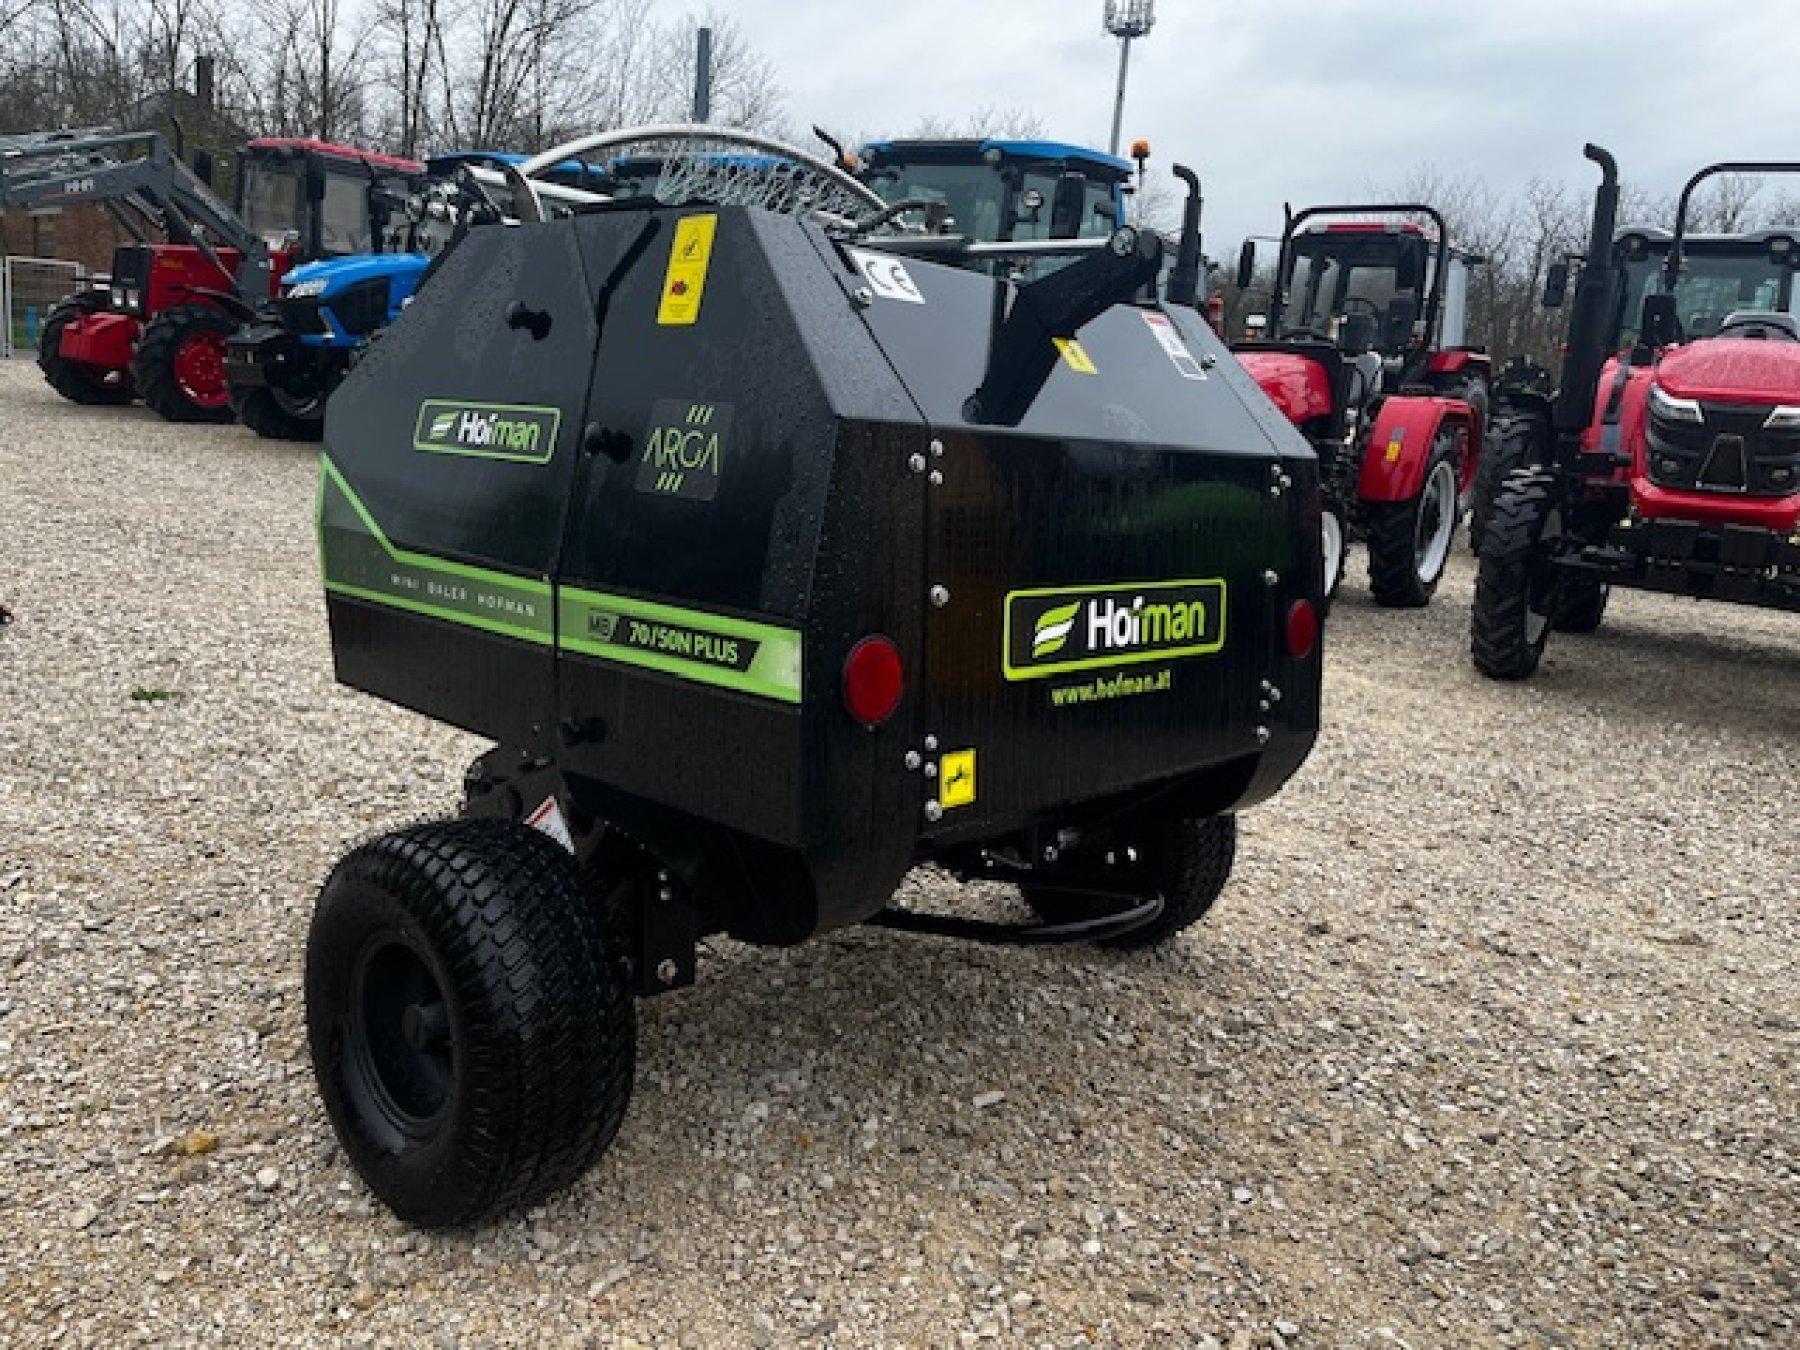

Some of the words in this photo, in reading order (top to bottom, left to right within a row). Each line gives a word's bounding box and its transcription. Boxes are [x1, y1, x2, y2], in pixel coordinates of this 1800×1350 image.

[640, 426, 718, 476] ARGA
[629, 621, 690, 654] 70/50N
[694, 634, 738, 665] PLUS
[1087, 595, 1205, 650] Hofman
